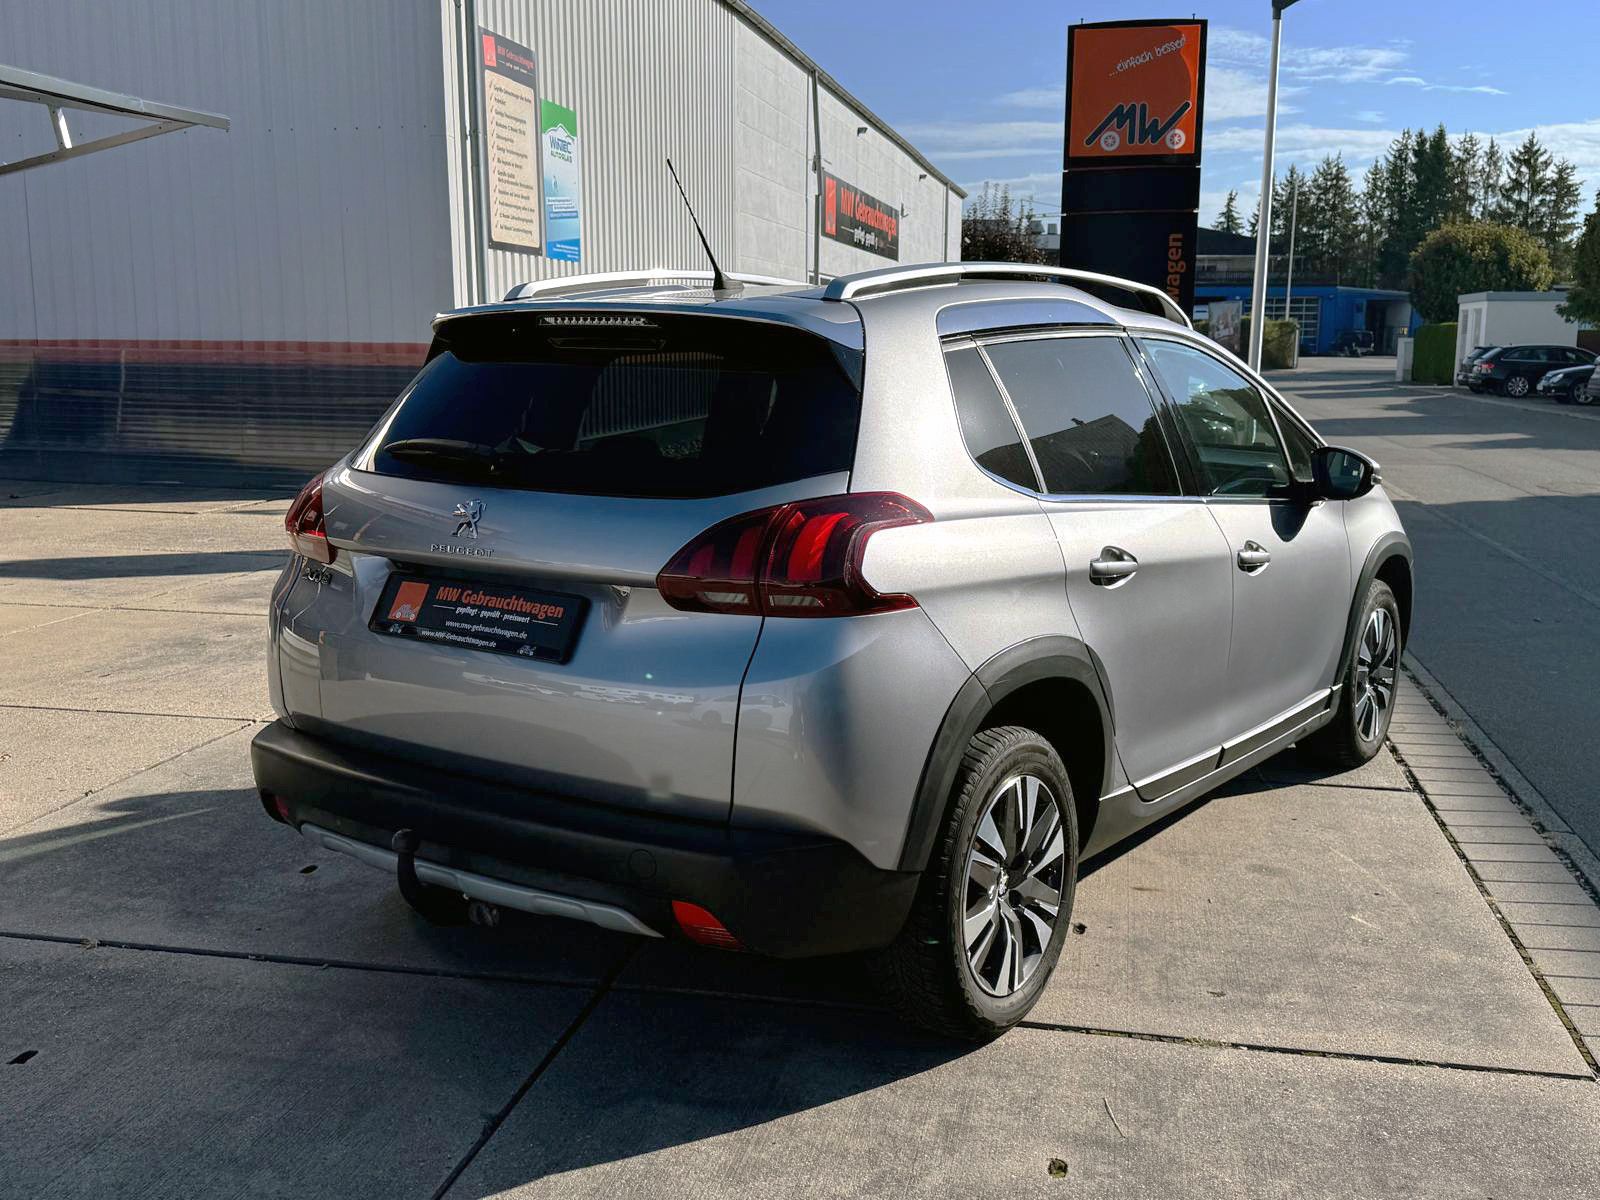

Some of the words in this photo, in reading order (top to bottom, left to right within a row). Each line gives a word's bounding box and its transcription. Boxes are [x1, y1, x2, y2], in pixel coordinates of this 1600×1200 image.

[1084, 101, 1191, 146] MW
[430, 543, 494, 558] PEUGEOT
[435, 586, 461, 602] MW
[461, 590, 564, 620] Gebrauchtwagen
[455, 606, 478, 616] gepflegt
[480, 609, 501, 619] geprüft
[502, 613, 530, 624] preiswert
